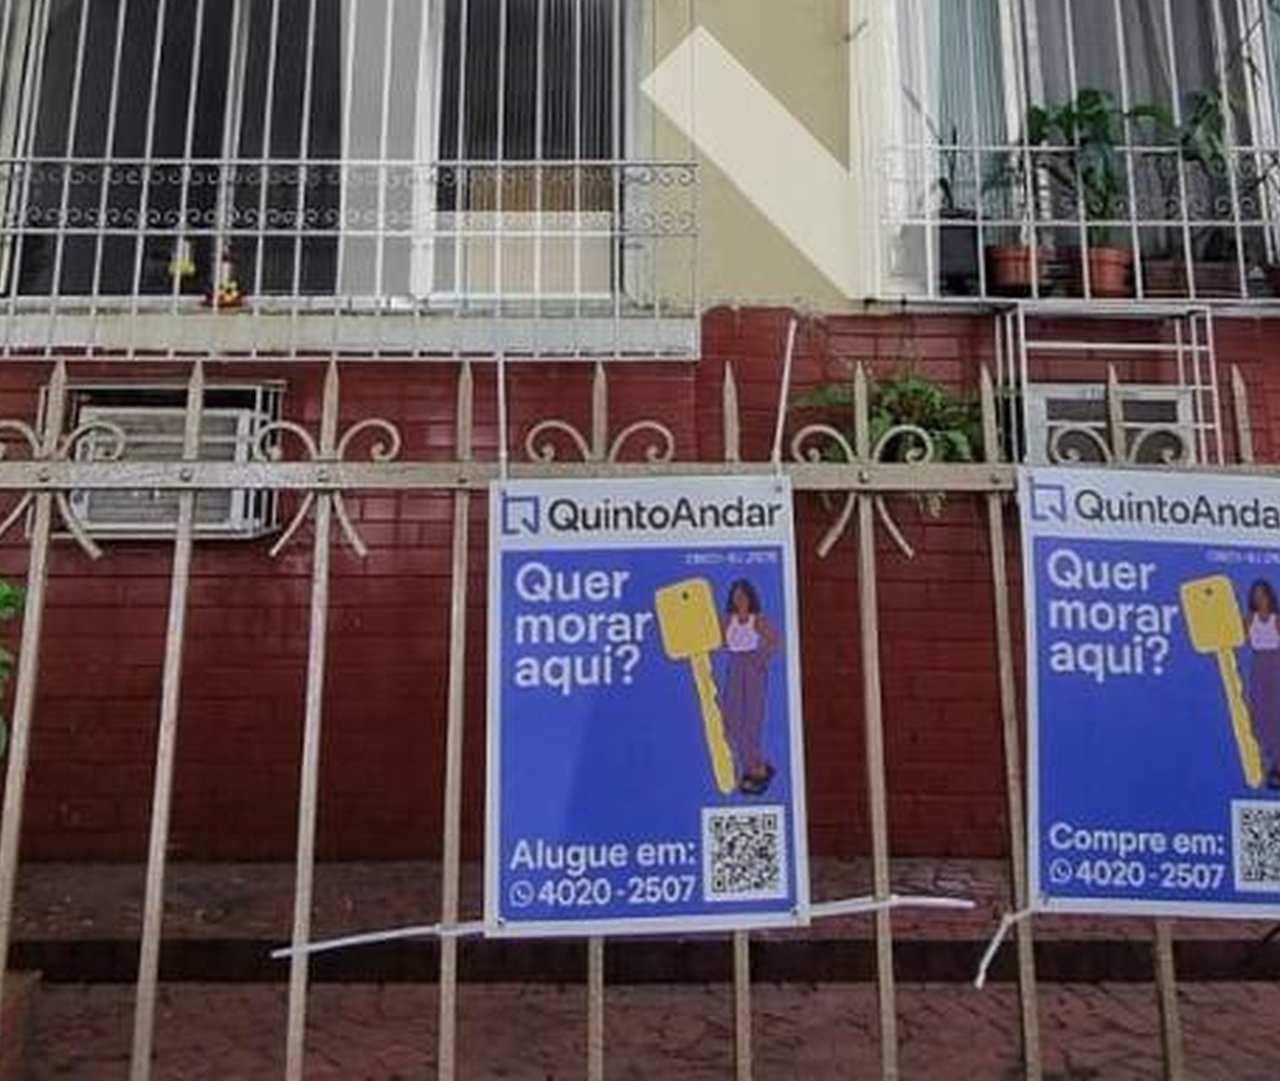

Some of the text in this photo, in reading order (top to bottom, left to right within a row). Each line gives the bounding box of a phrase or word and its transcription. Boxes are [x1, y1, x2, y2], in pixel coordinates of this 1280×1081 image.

[547, 495, 782, 532] QuintoAndar
[515, 561, 630, 603] Quer
[1047, 548, 1157, 591] Quer
[516, 609, 655, 645] morar
[1048, 597, 1180, 635] morar
[515, 643, 642, 696] aqui?
[1049, 634, 1170, 683] aqui?
[509, 838, 696, 877] Alugue em:
[1048, 821, 1225, 859] Compre em:
